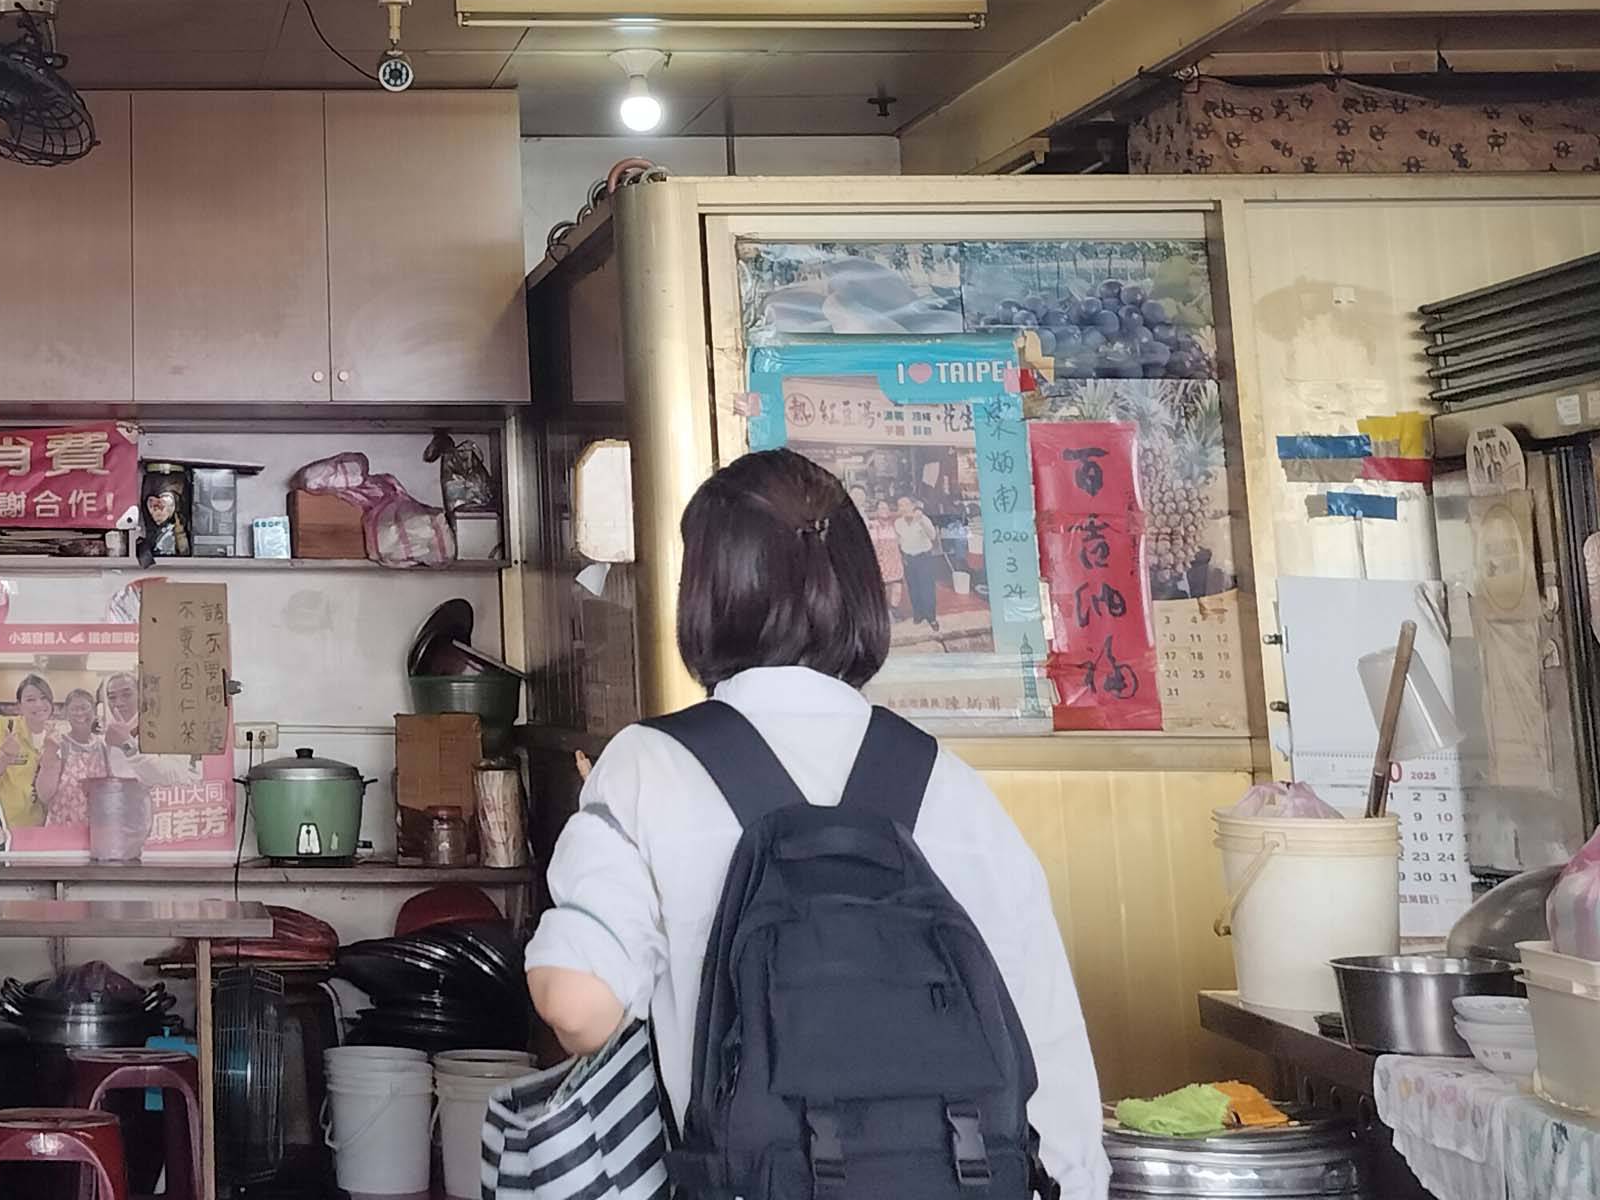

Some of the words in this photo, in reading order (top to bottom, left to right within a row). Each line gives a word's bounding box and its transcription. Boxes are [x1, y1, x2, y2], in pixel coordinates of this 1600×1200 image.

[897, 363, 905, 384] I
[150, 783, 224, 808] 中山大同
